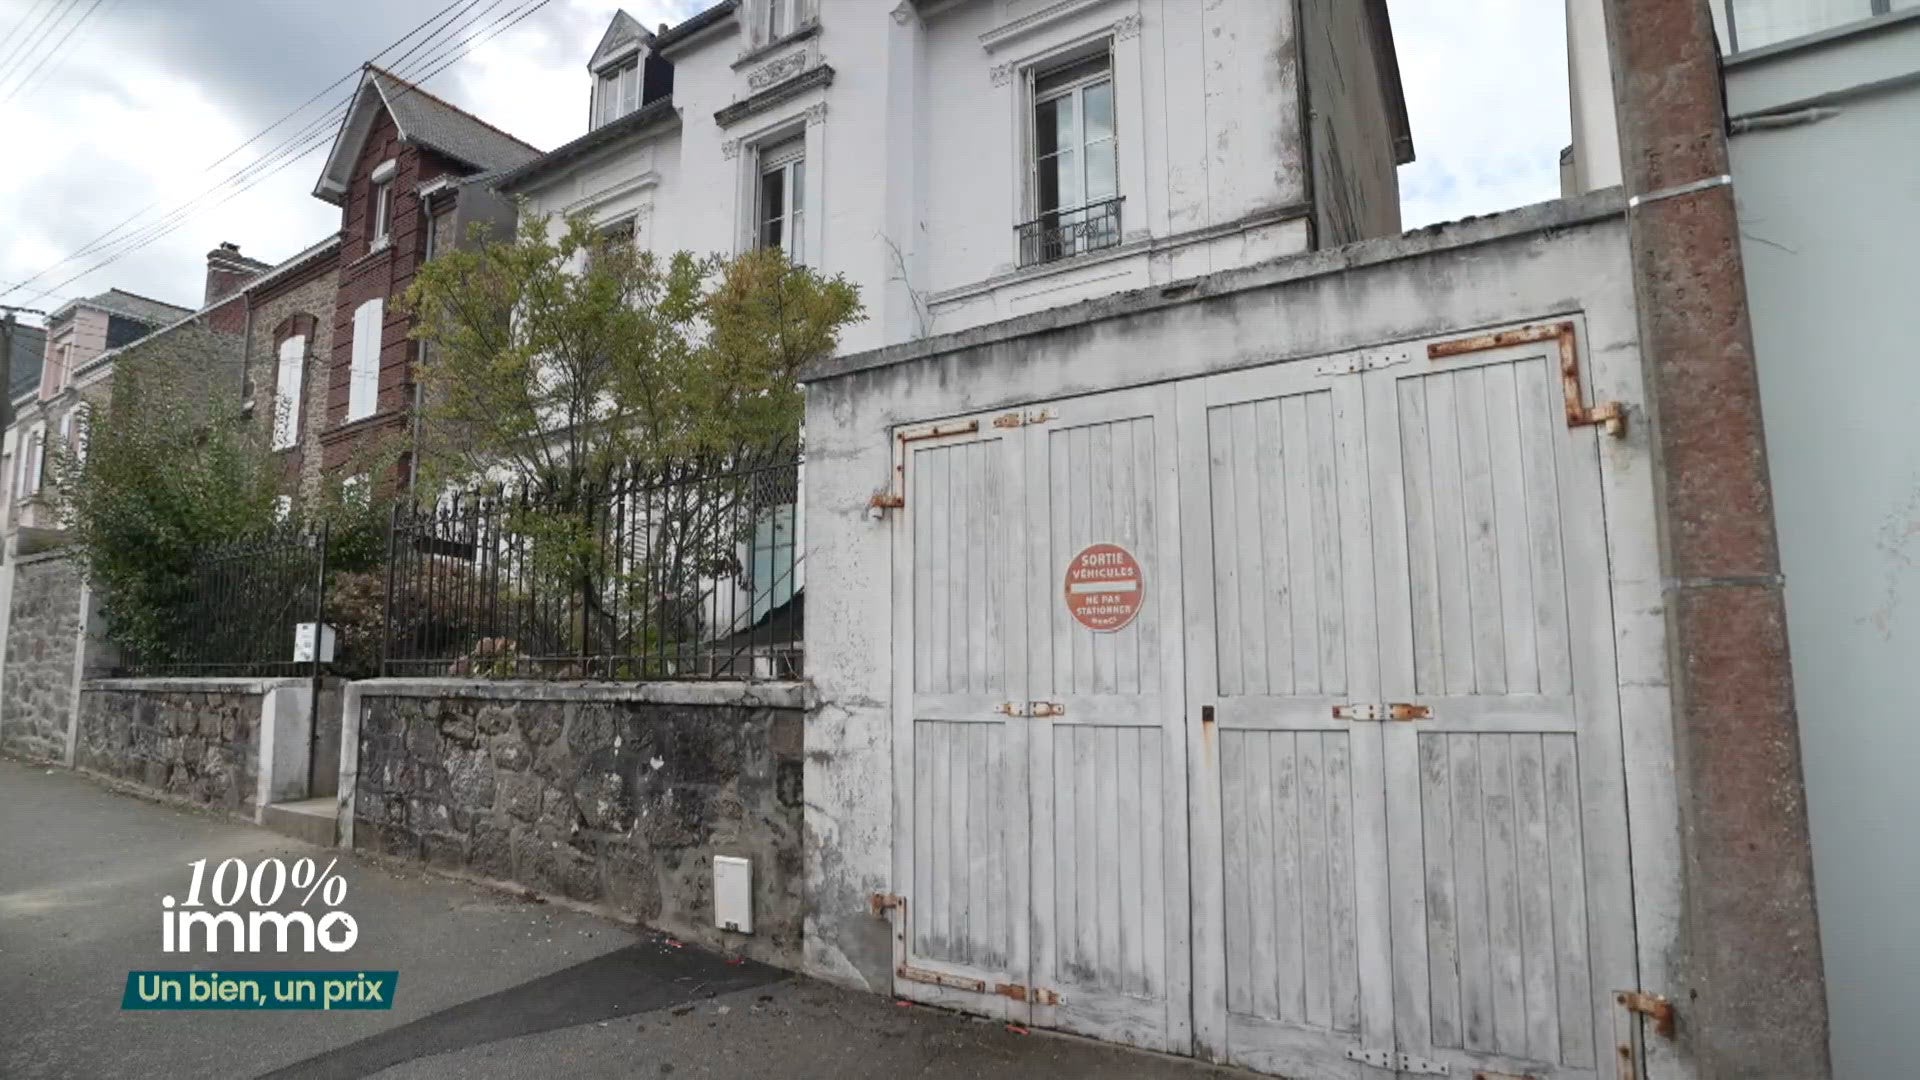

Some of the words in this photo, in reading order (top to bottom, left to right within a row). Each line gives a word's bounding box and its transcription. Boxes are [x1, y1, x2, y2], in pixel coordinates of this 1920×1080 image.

[1081, 552, 1124, 567] SORTIE
[1073, 567, 1134, 579] VÉHICULES
[1086, 595, 1098, 605] NE
[1102, 595, 1120, 604] PAS
[1076, 605, 1131, 615] STATIONNER
